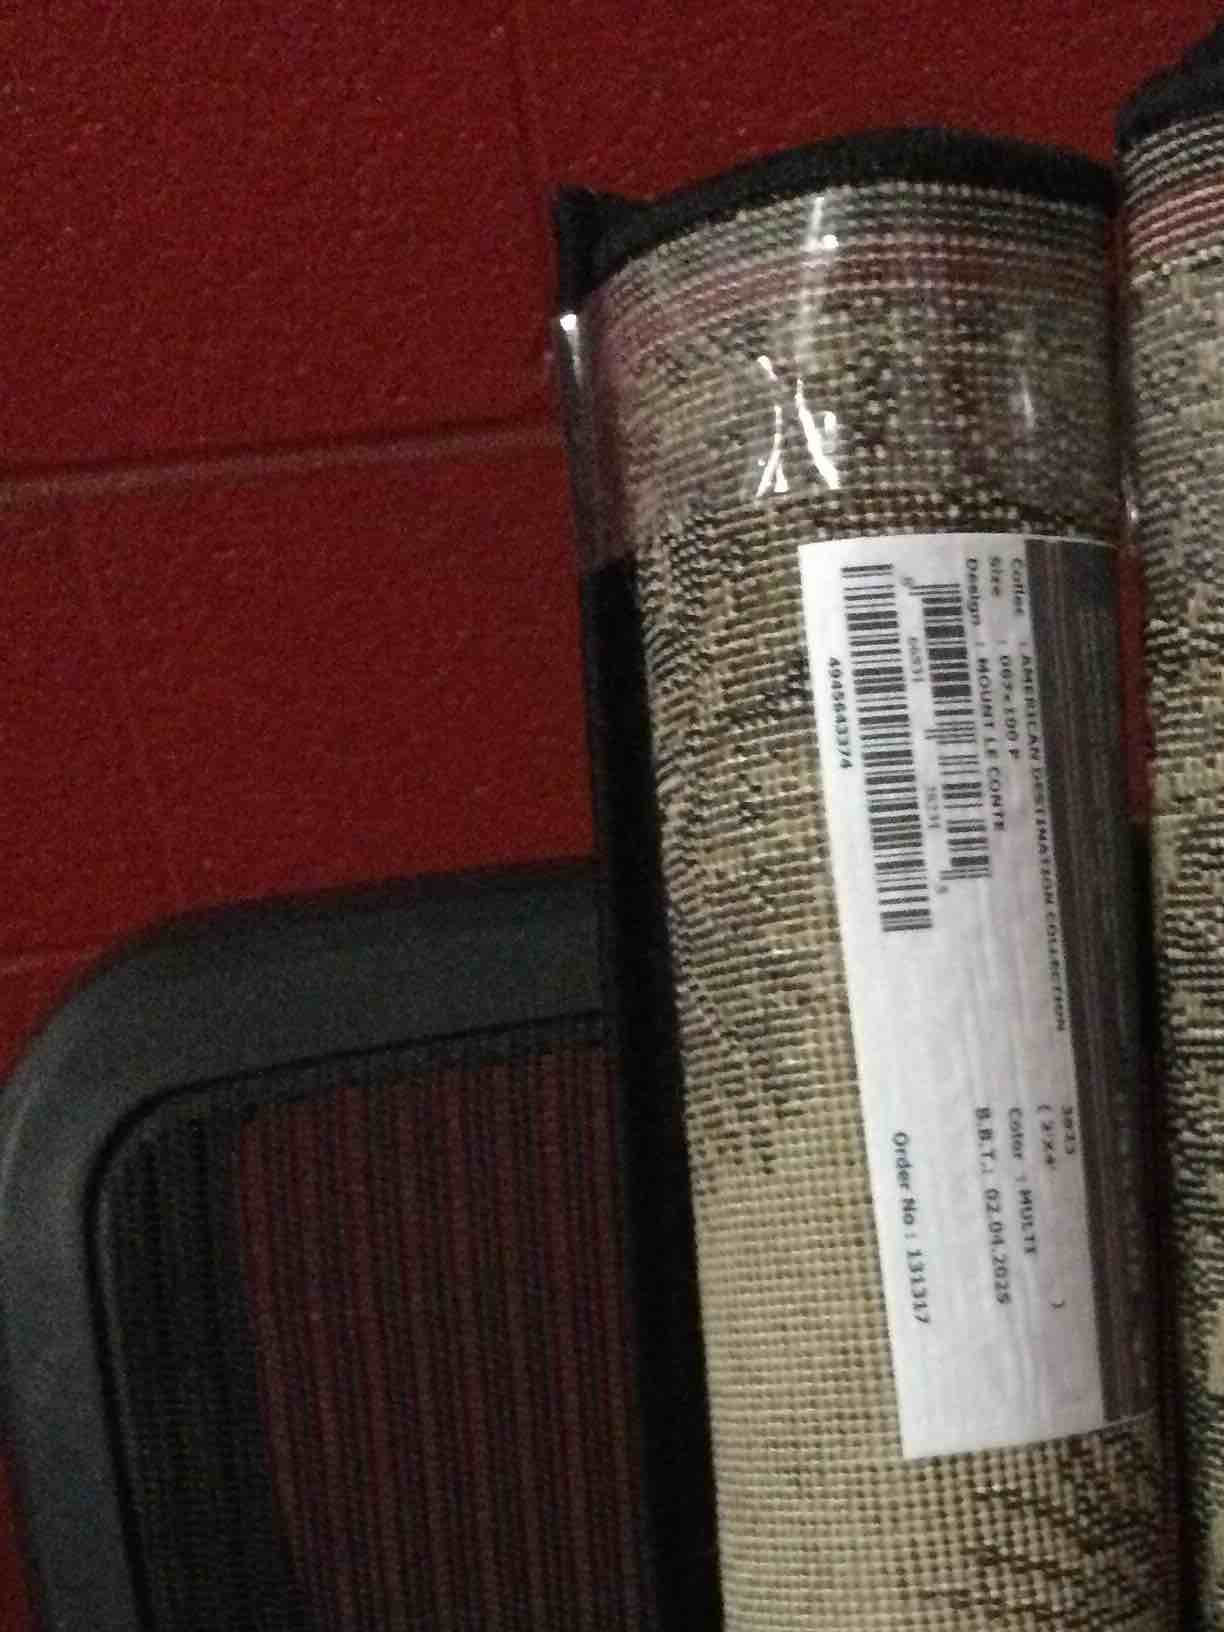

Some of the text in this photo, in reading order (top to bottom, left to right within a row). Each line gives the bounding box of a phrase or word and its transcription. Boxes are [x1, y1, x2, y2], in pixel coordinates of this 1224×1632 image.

[990, 556, 1004, 597] Size
[966, 558, 1006, 832] Design MOUNT LE CONTE
[1022, 655, 1040, 761] AMERICAN
[1032, 768, 1056, 905] DESTINATION
[1046, 911, 1066, 1032] COLLECTION
[892, 1131, 913, 1190] Order
[906, 1249, 930, 1324] 131317
[1008, 1107, 1038, 1256] Color MULTI
